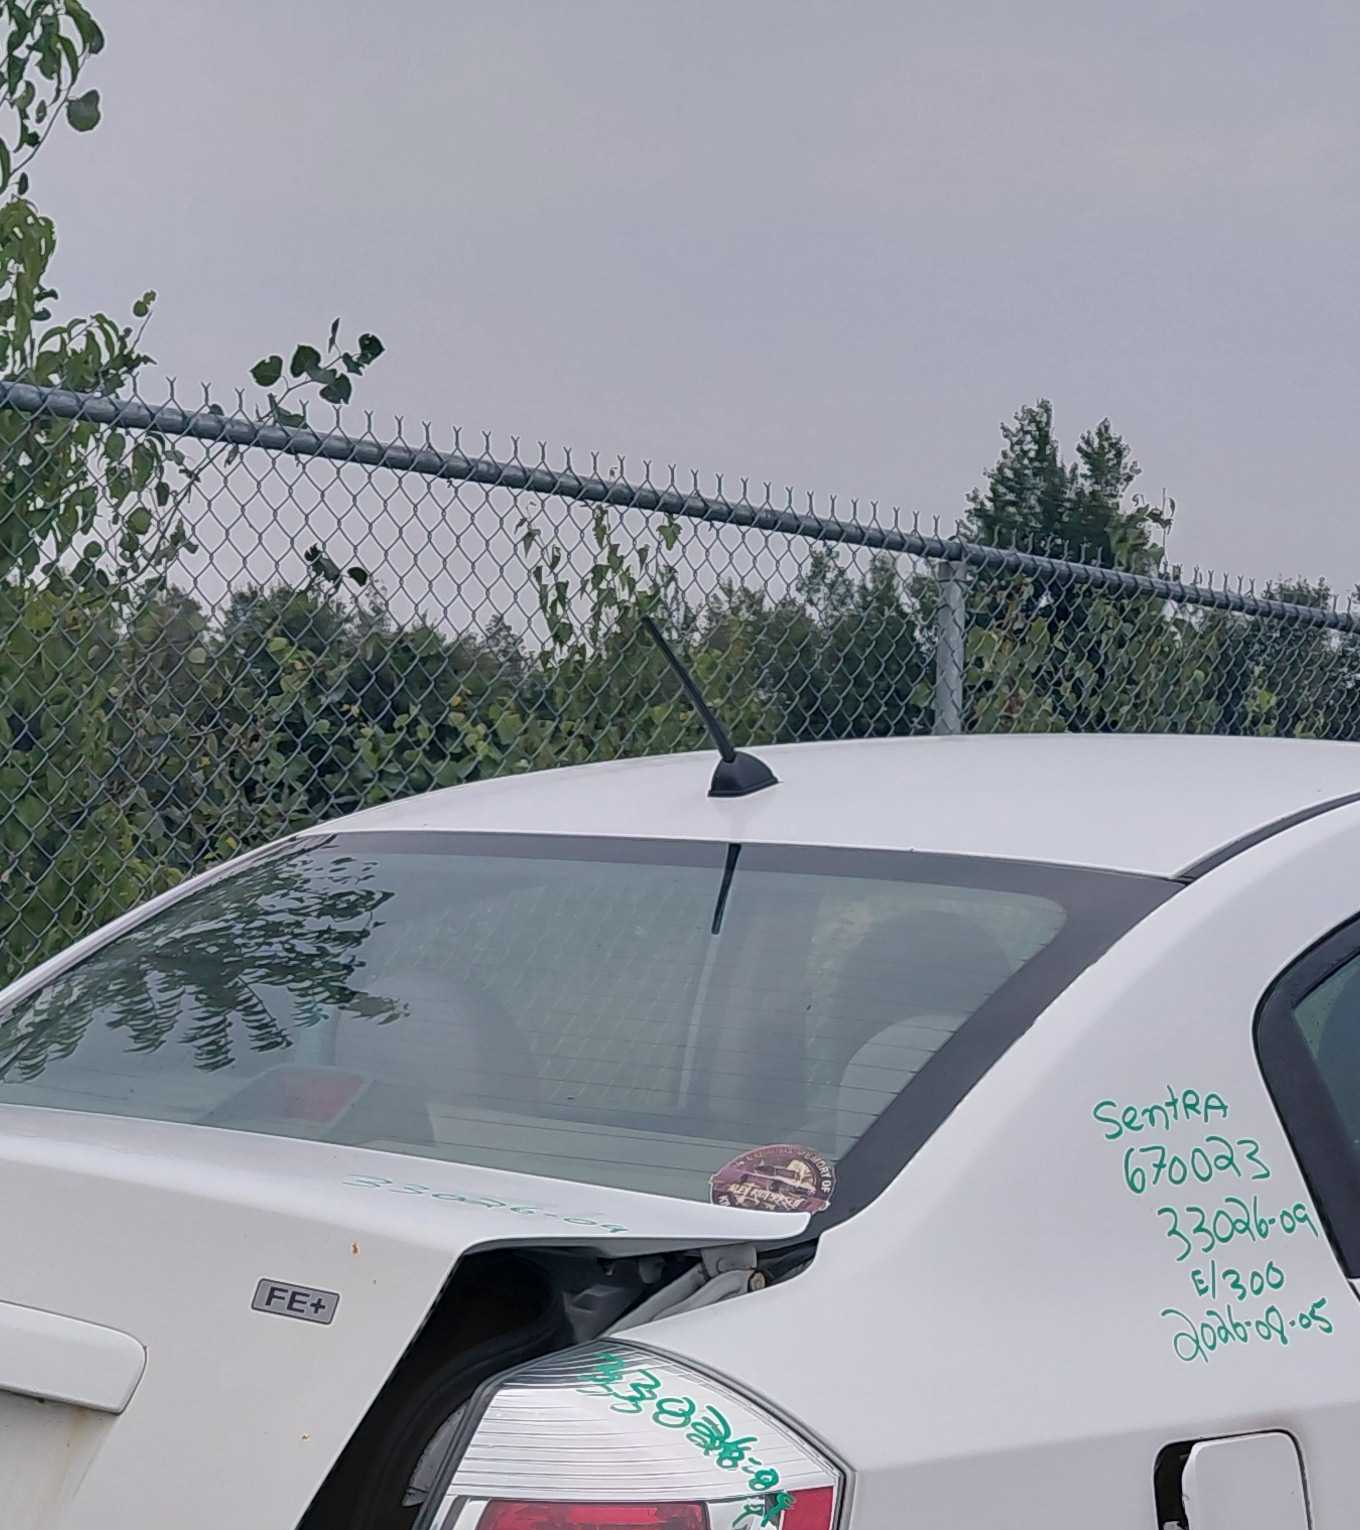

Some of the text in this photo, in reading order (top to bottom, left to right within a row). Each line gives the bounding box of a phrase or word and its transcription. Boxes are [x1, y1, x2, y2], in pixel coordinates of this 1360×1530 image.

[1124, 1135, 1271, 1194] 670023
[1157, 1195, 1319, 1261] 33026-09
[264, 1285, 326, 1314] FE+
